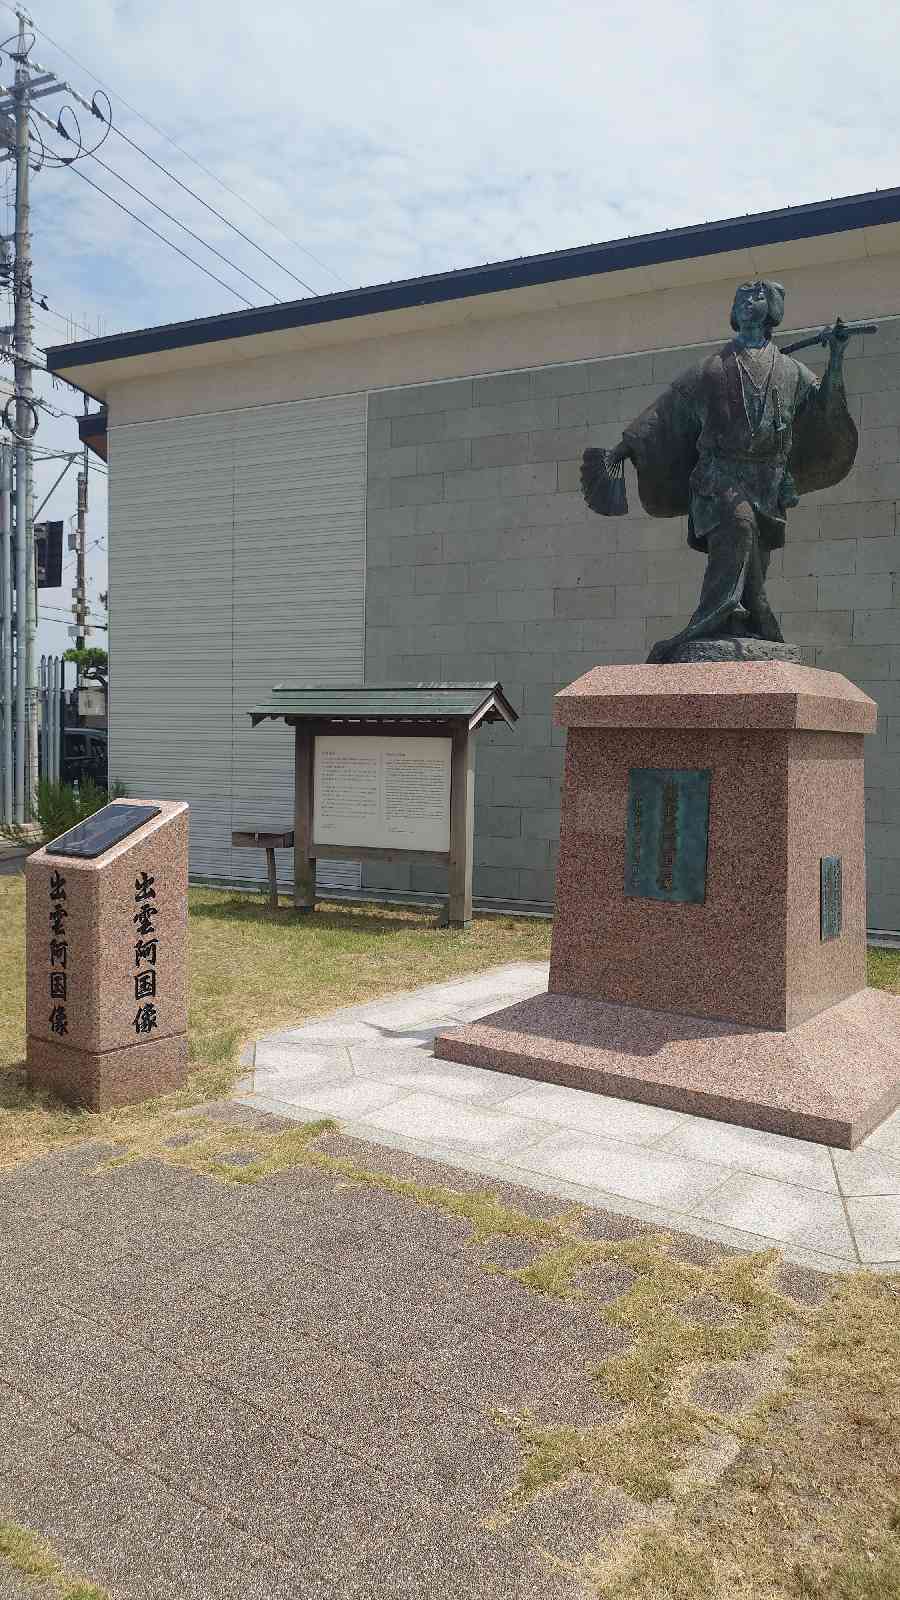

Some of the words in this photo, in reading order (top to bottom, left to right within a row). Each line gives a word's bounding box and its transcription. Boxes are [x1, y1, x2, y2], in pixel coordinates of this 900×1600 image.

[49, 870, 69, 1035] 出雲阿国像
[132, 871, 159, 1034] 出雲阿国像
